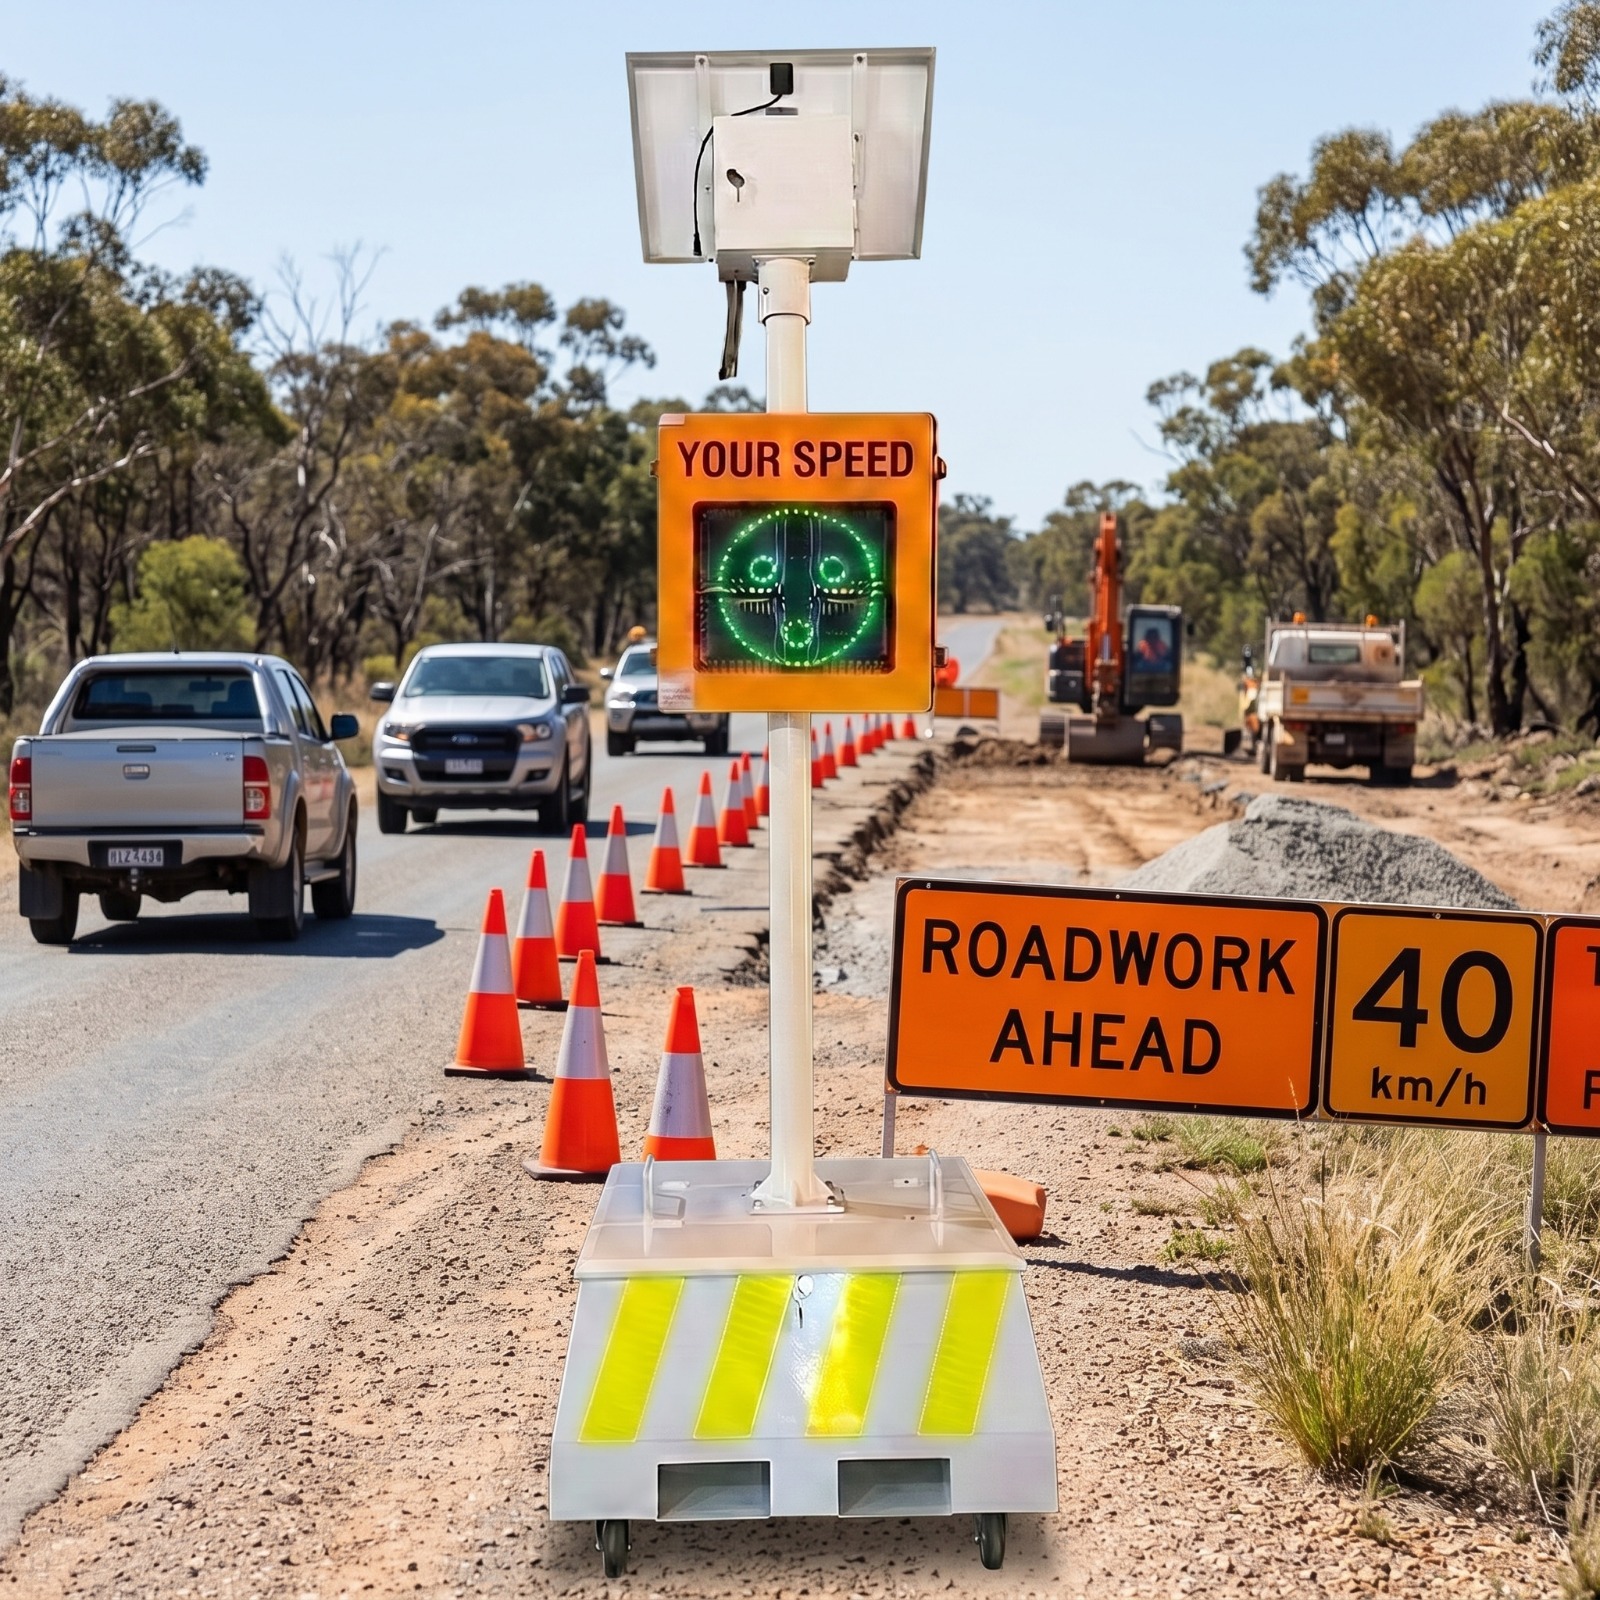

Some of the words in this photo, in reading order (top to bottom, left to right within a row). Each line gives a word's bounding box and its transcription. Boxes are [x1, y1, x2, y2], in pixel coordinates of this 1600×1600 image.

[677, 440, 780, 478] YOUR
[793, 440, 914, 478] SPEED
[922, 918, 1296, 995] ROADWORK
[1351, 947, 1514, 1054] 40
[989, 1008, 1222, 1076] AHEAD
[1371, 1065, 1487, 1108] km/h
